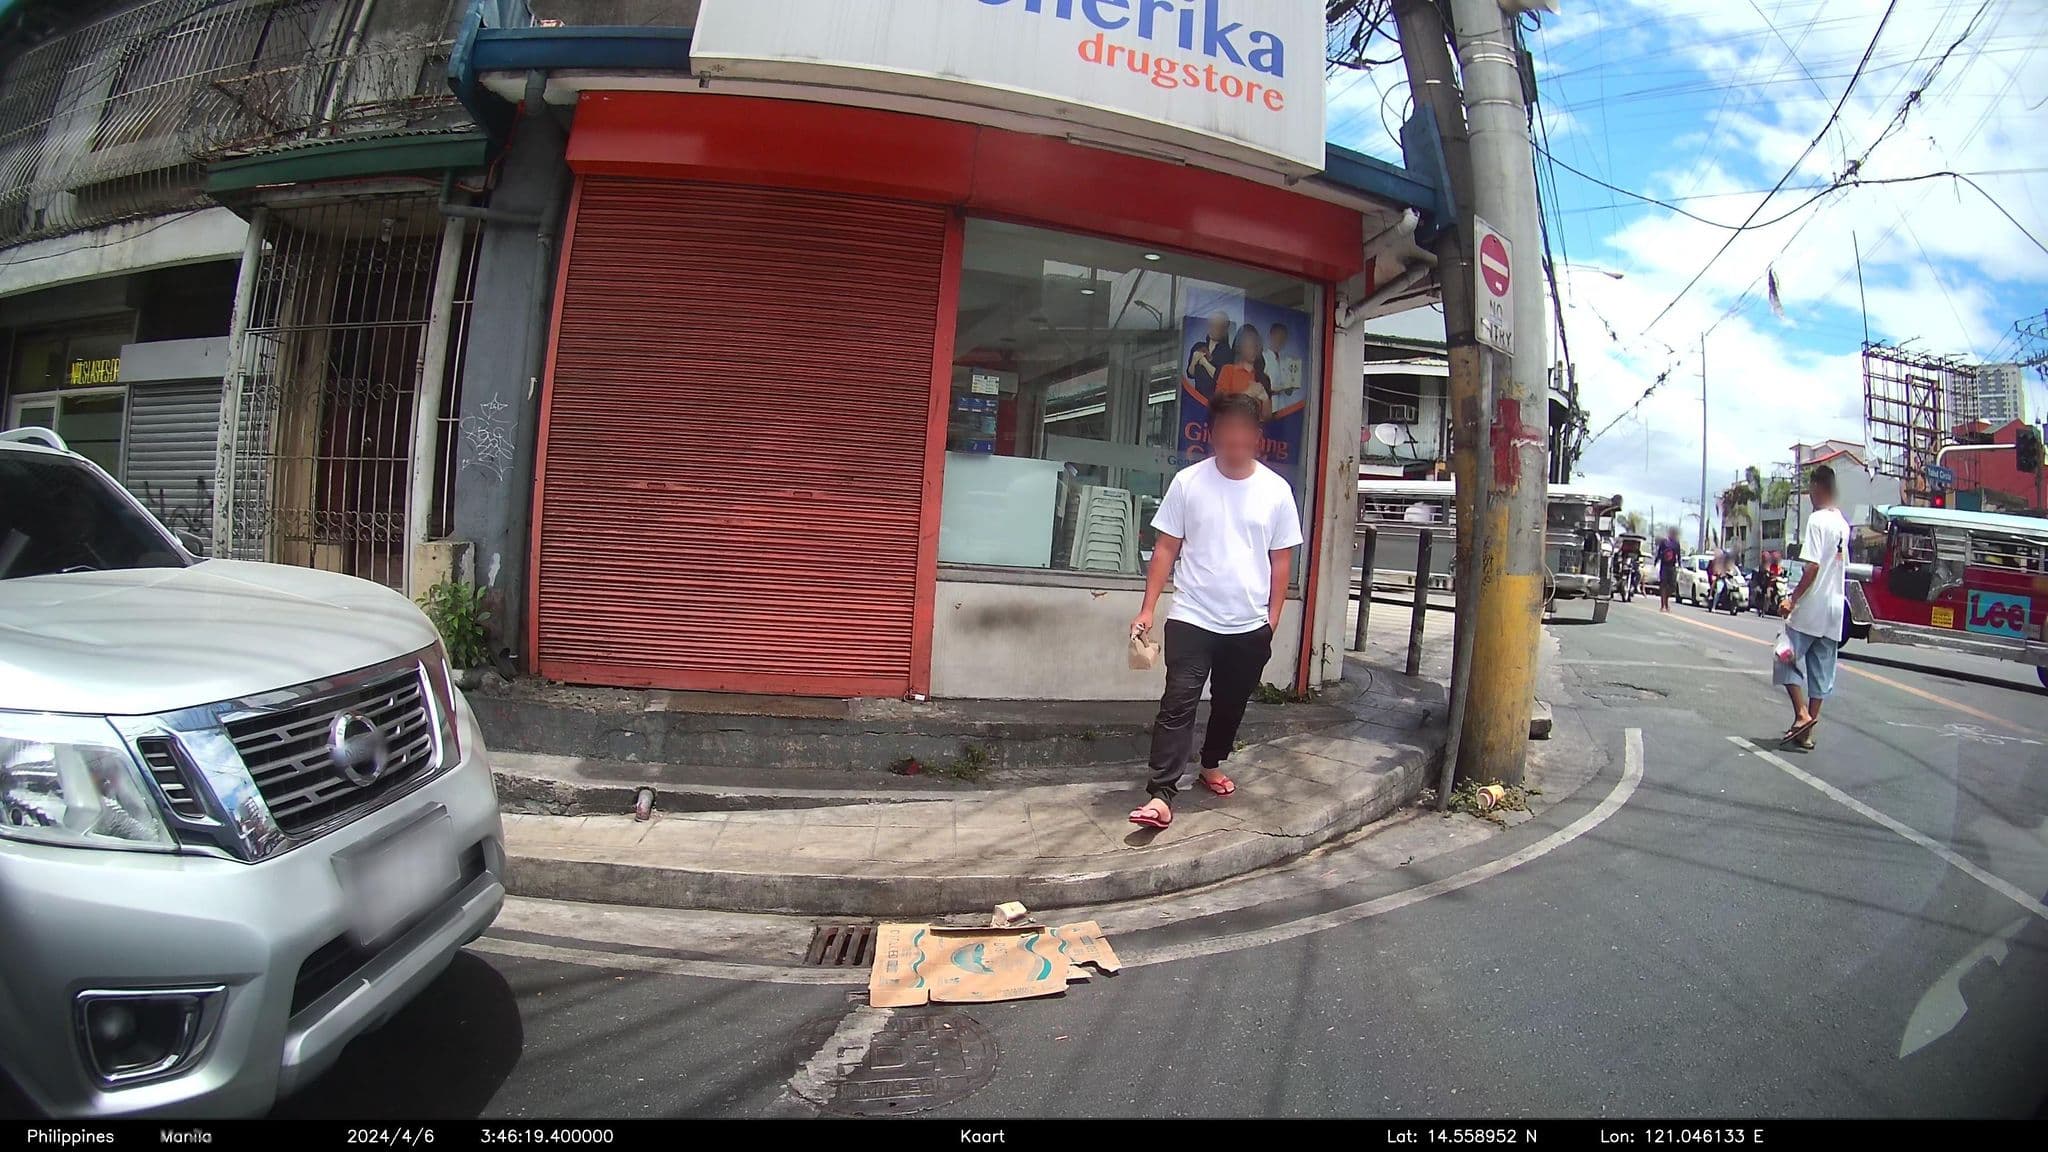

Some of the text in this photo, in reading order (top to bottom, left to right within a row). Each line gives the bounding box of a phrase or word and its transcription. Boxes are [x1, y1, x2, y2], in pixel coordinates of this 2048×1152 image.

[1078, 32, 1284, 112] drugstore
[1489, 299, 1503, 319] NO
[1969, 592, 2026, 632] Lee
